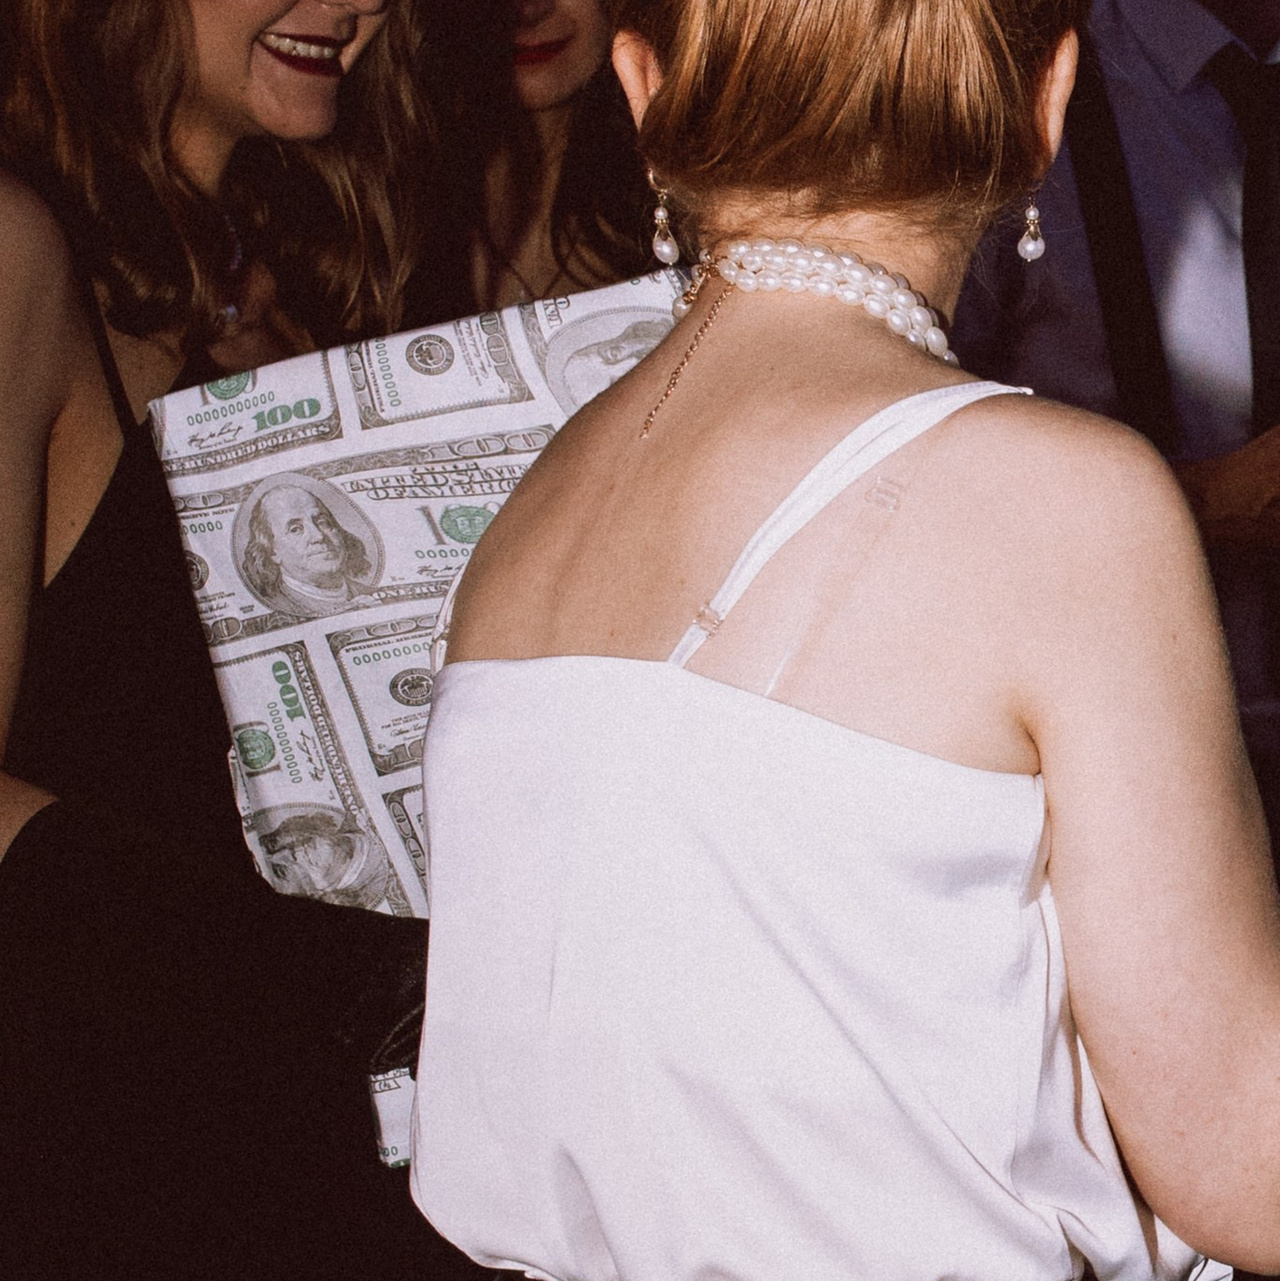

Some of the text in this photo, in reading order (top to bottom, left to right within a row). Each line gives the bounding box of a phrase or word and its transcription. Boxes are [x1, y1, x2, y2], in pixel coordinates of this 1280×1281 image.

[252, 398, 322, 433] 100
[181, 441, 257, 471] HUNDRED
[257, 423, 332, 451] DOLLARS
[407, 478, 520, 498] AMERIC
[415, 547, 475, 559] 00000
[272, 660, 307, 722] 100
[292, 650, 323, 715] DOLLARS
